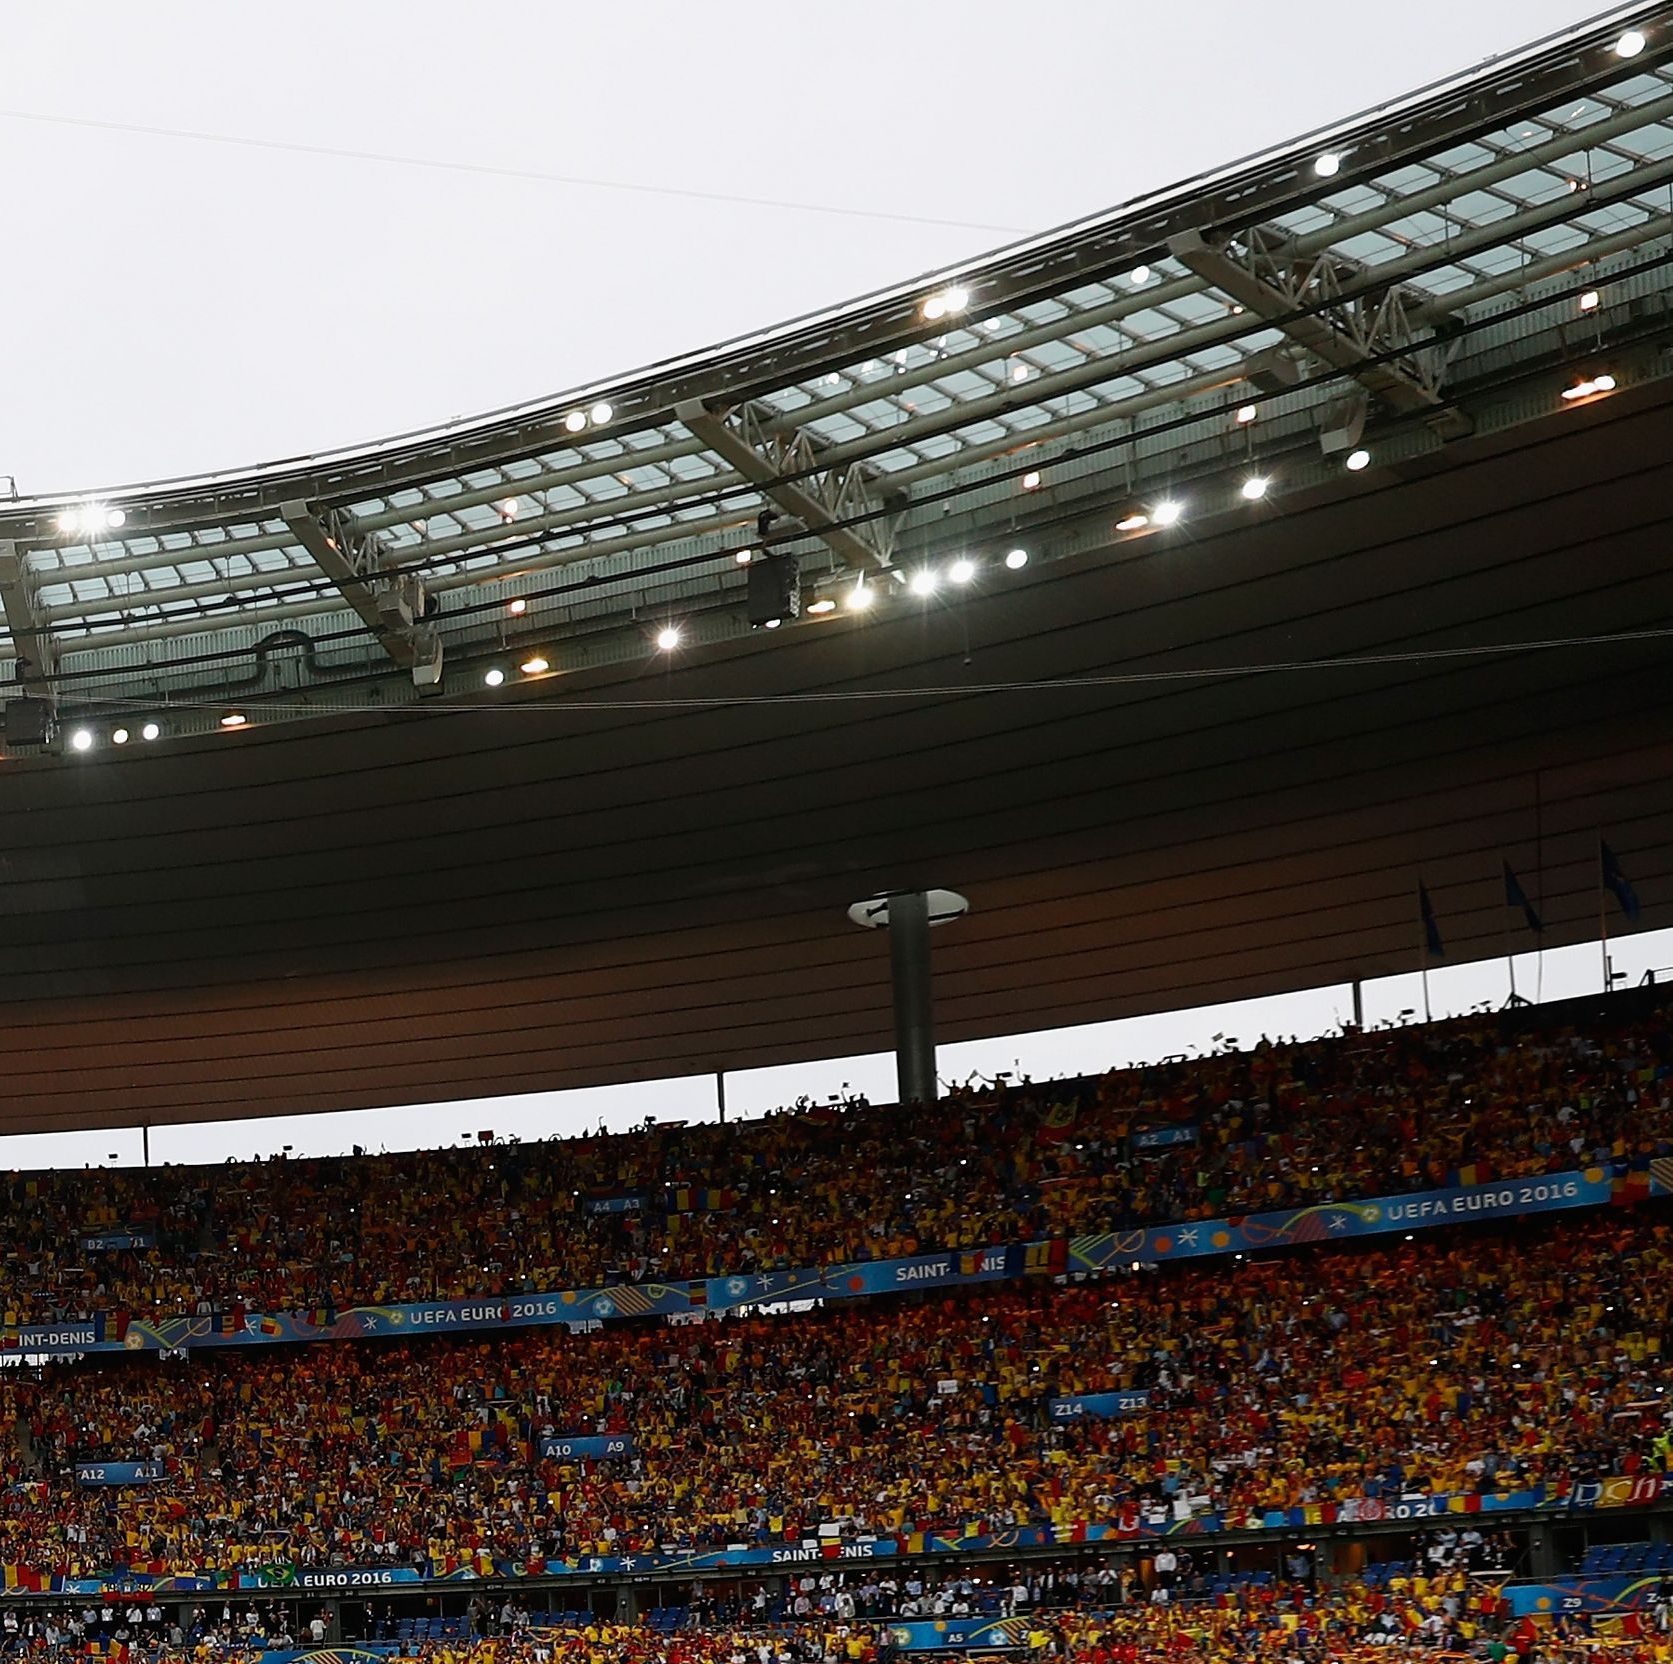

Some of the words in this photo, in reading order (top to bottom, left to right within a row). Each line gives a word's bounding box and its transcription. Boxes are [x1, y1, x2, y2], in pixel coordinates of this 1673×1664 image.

[1173, 1129, 1193, 1142] A1
[593, 1202, 610, 1213] A4
[1388, 1201, 1448, 1221] UEFA
[1453, 1191, 1515, 1212] EURO
[1520, 1182, 1578, 1203] 2016
[411, 1308, 456, 1324] UEFA
[513, 1302, 557, 1317] 2016
[1055, 1403, 1083, 1416] Z14
[1119, 1397, 1148, 1410] Z13
[546, 1445, 571, 1457] A10
[607, 1441, 624, 1453] A9
[80, 1469, 104, 1480] A12
[304, 1575, 344, 1588] EURO
[352, 1572, 391, 1585] 2016
[1563, 1597, 1583, 1608] Z9
[948, 1634, 964, 1643] A5
